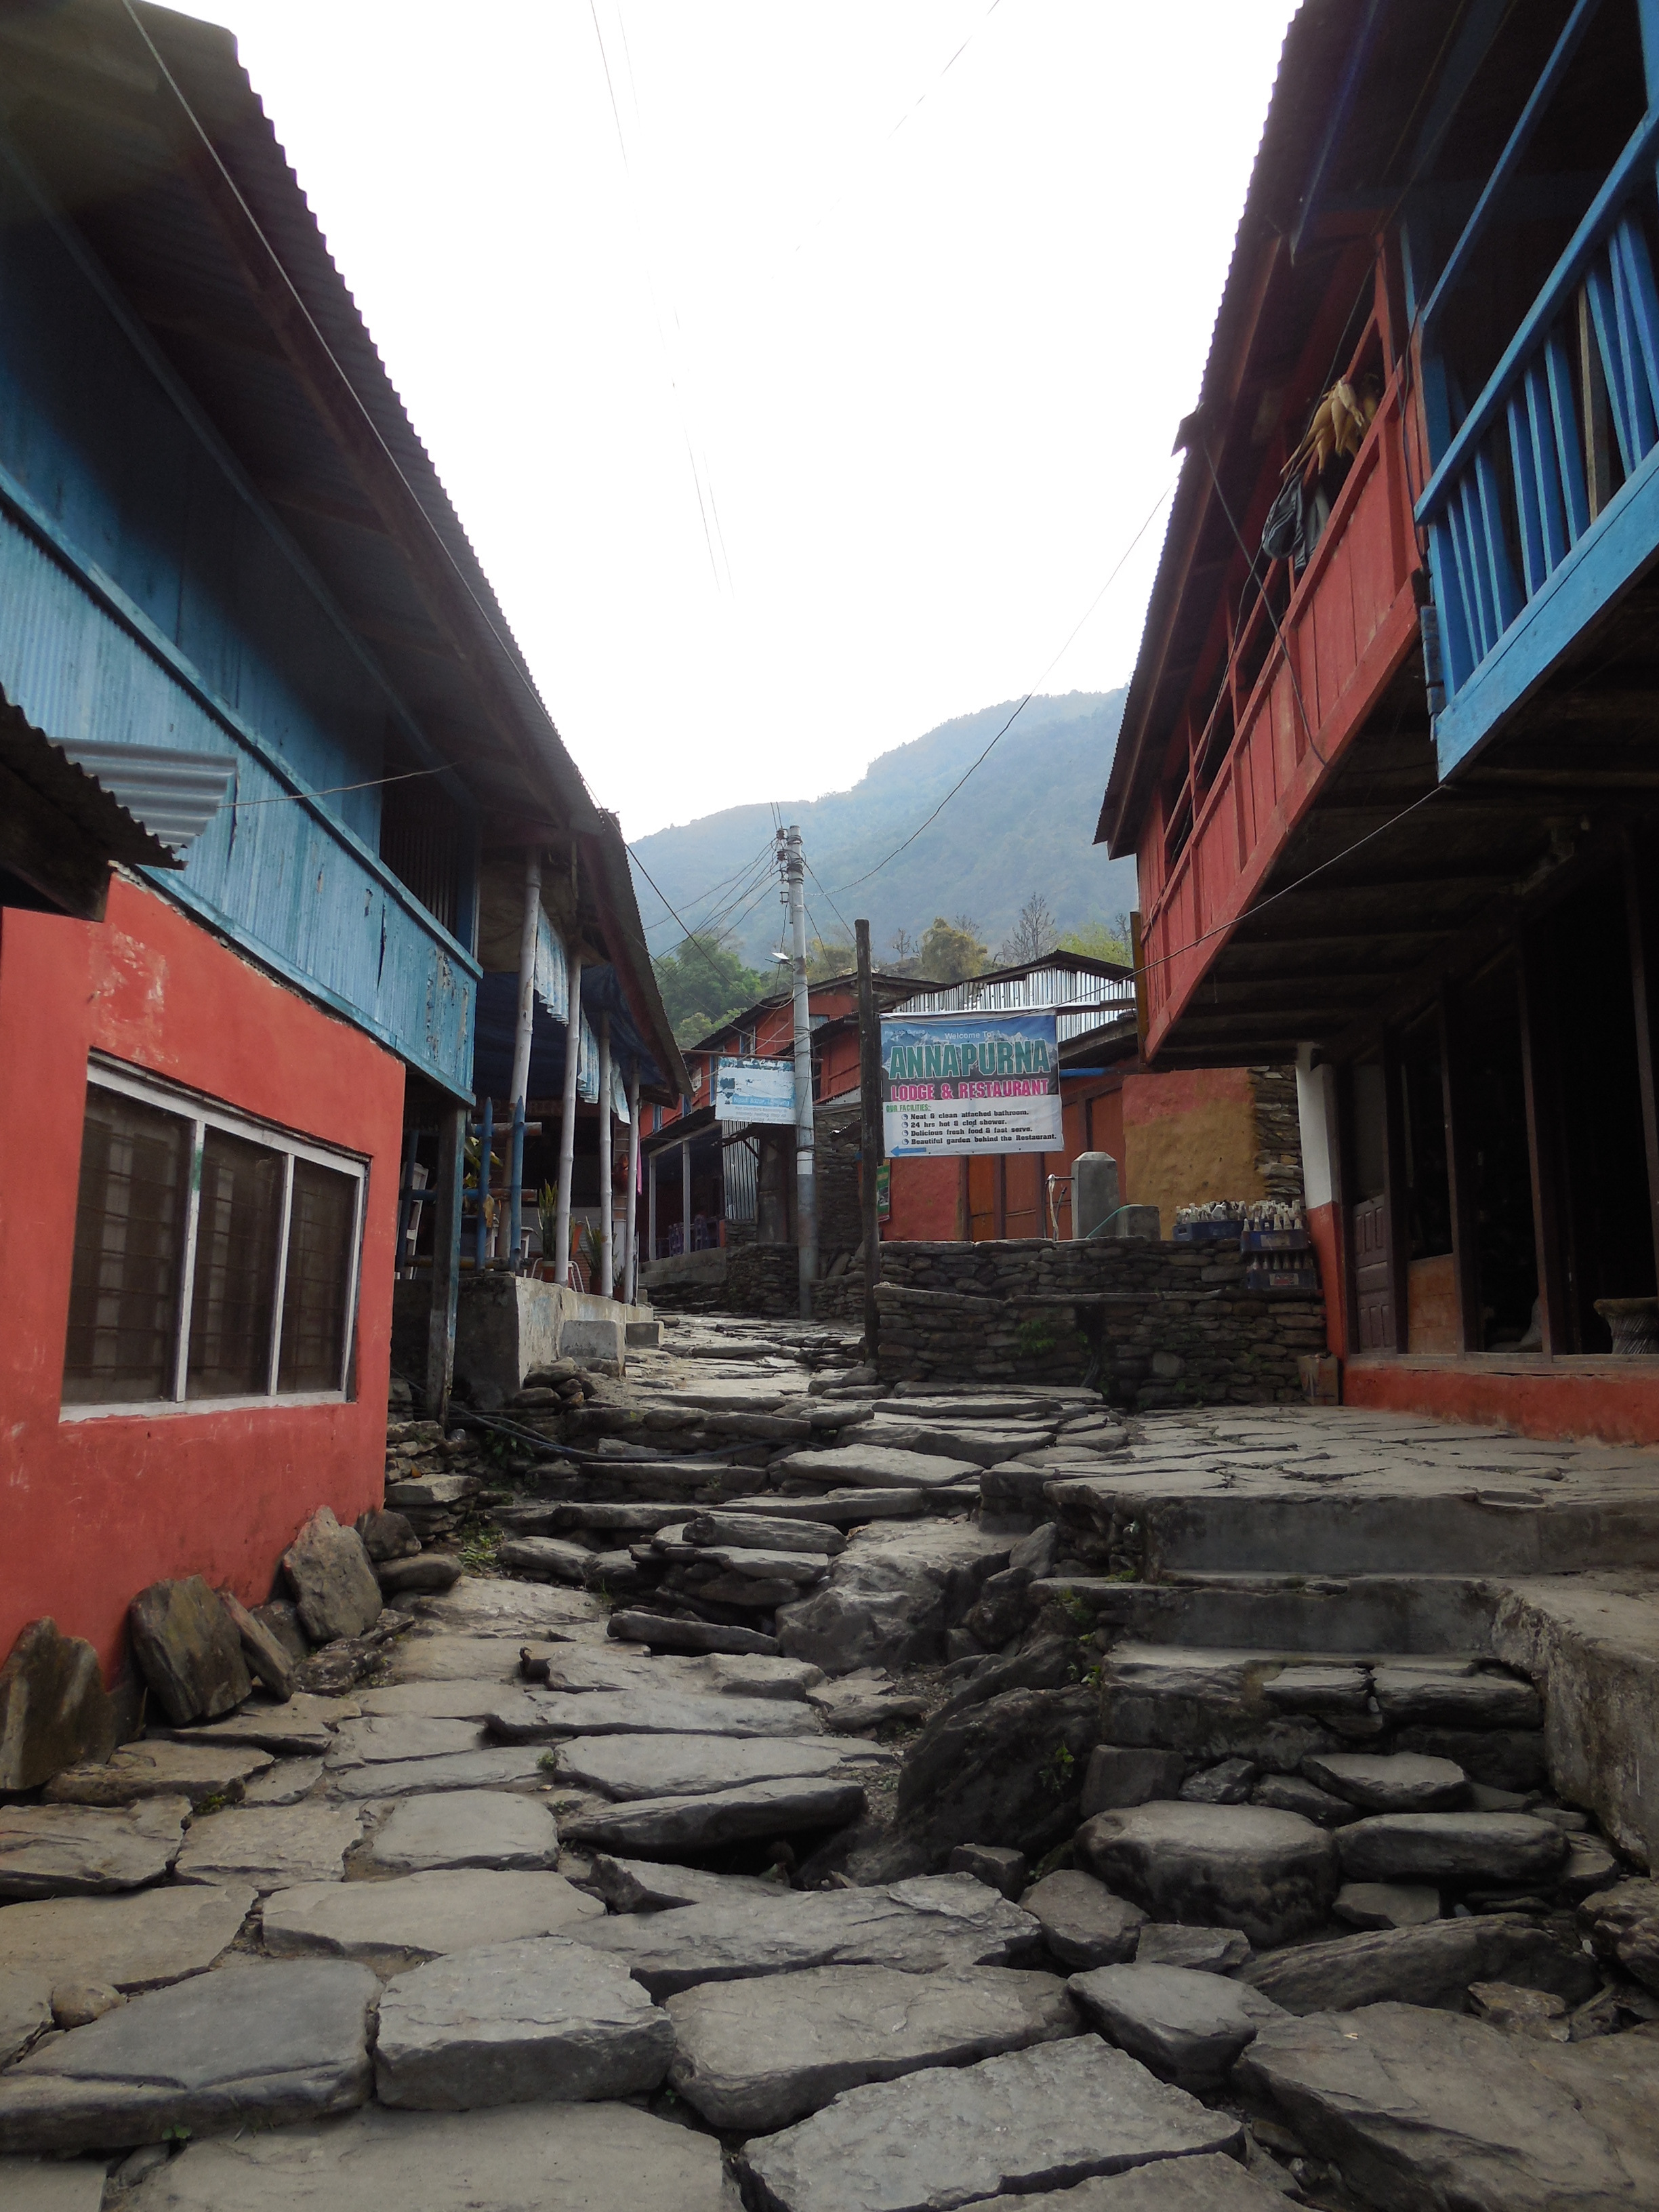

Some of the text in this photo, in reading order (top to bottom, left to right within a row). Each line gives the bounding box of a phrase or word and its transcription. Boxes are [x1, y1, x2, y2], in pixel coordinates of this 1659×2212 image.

[944, 1030, 991, 1040] Welcome To
[888, 1038, 1051, 1080] ANNAPURNA
[891, 1078, 1049, 1101] LODGE & RESTAURANT
[946, 1136, 971, 1145] garden
